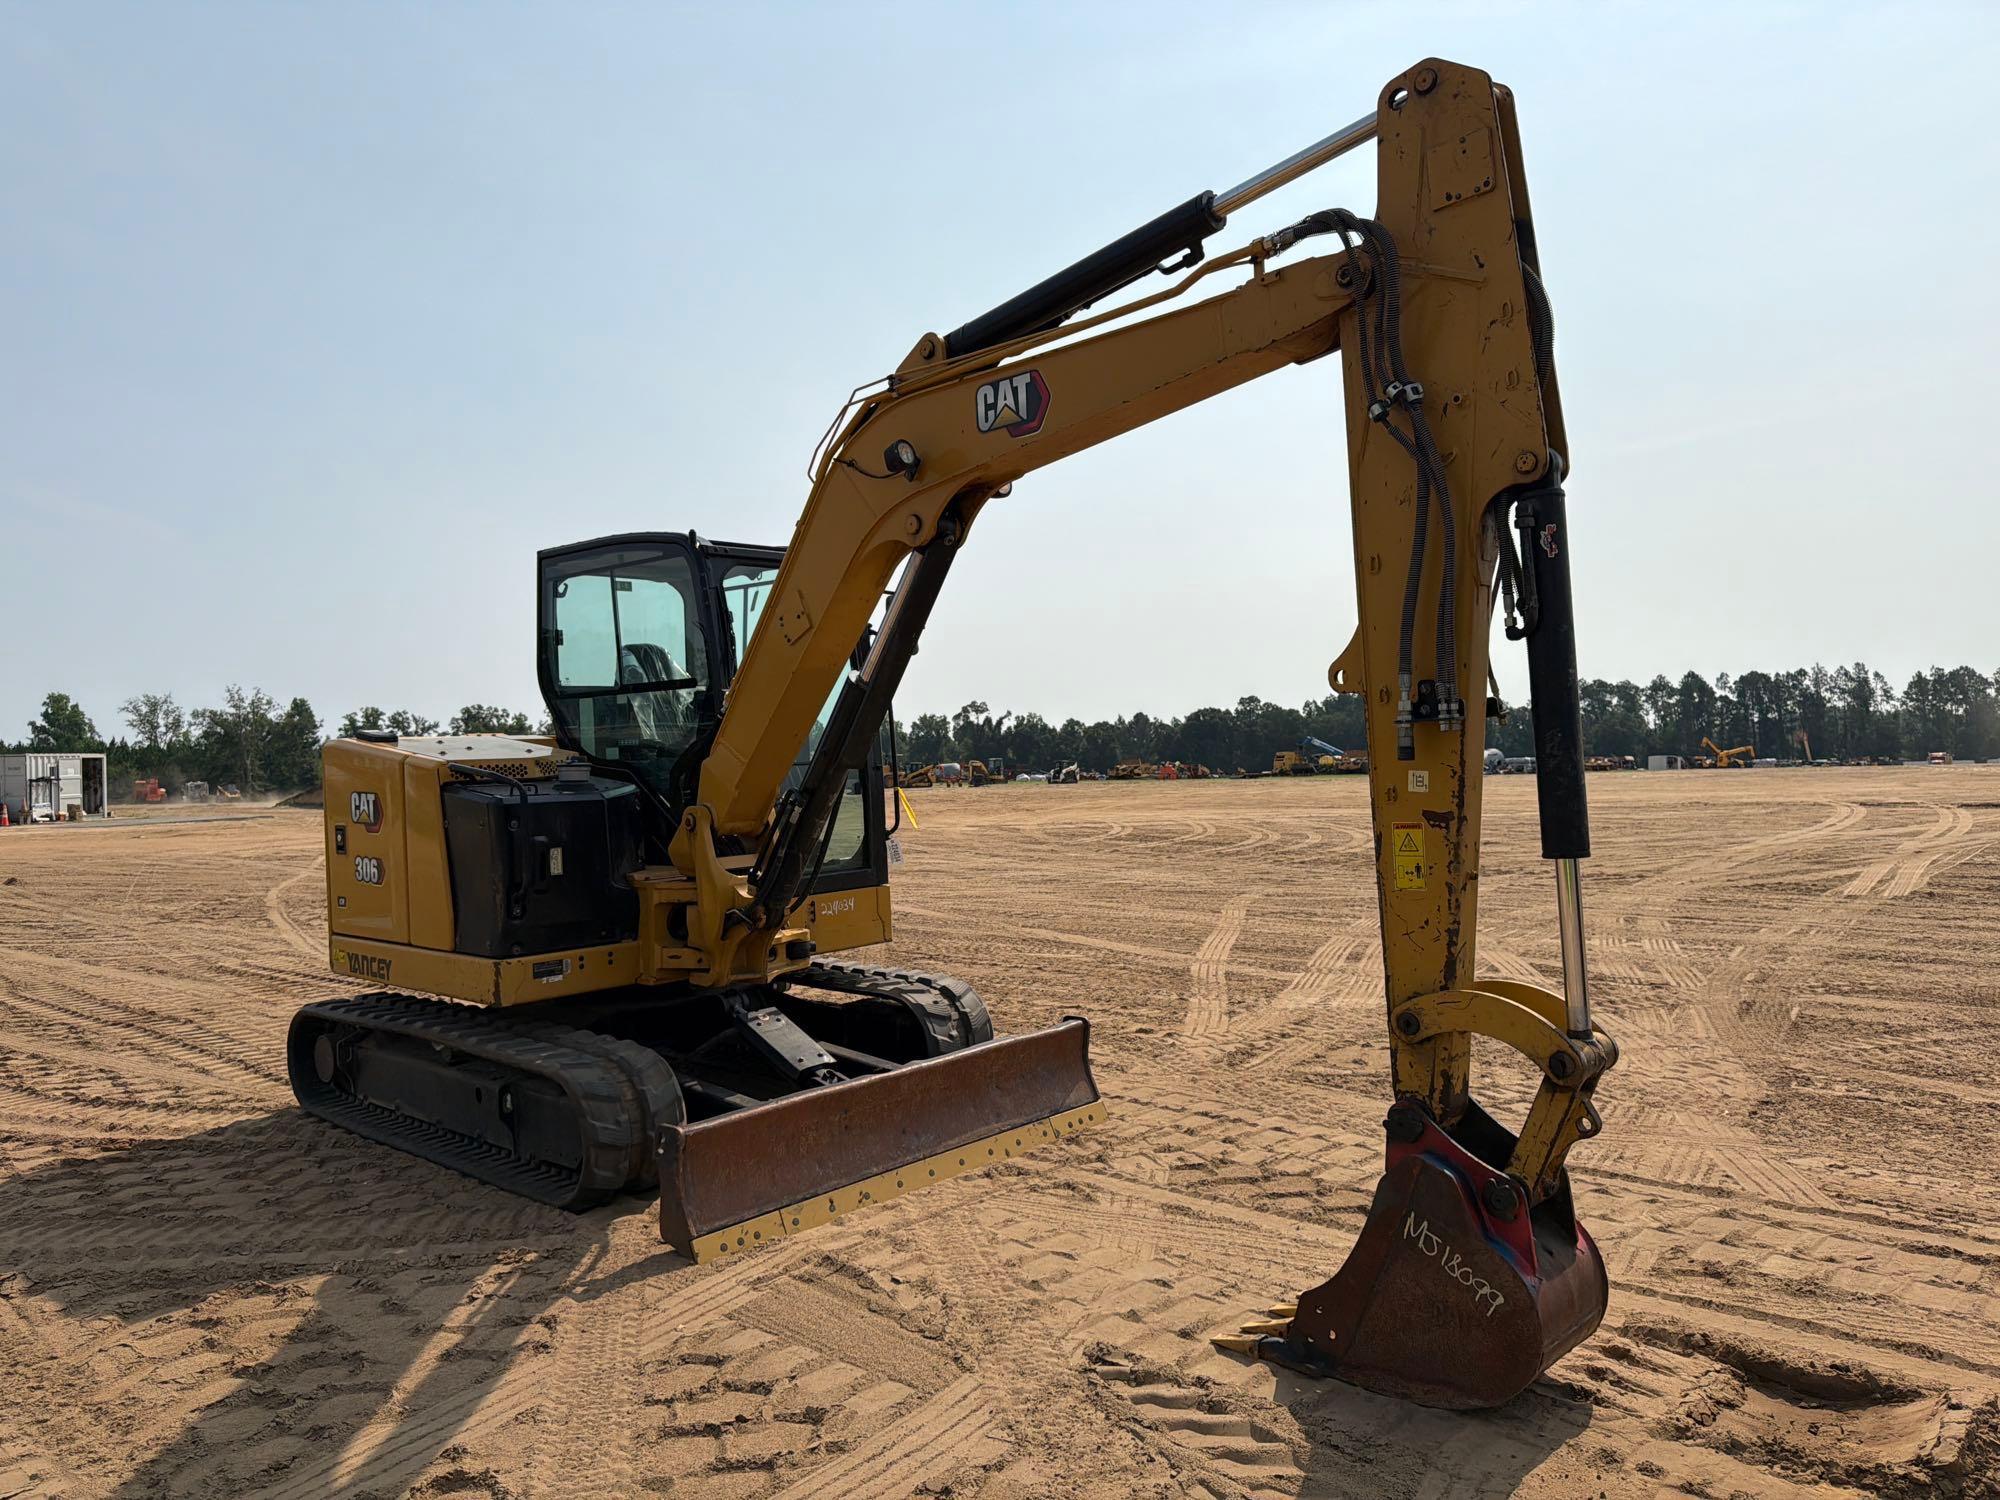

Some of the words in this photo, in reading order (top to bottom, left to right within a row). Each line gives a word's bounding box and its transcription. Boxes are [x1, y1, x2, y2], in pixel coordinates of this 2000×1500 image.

[976, 372, 1031, 432] CAT
[351, 792, 376, 823] CAT
[355, 856, 379, 883] 306
[821, 896, 855, 916] 224034
